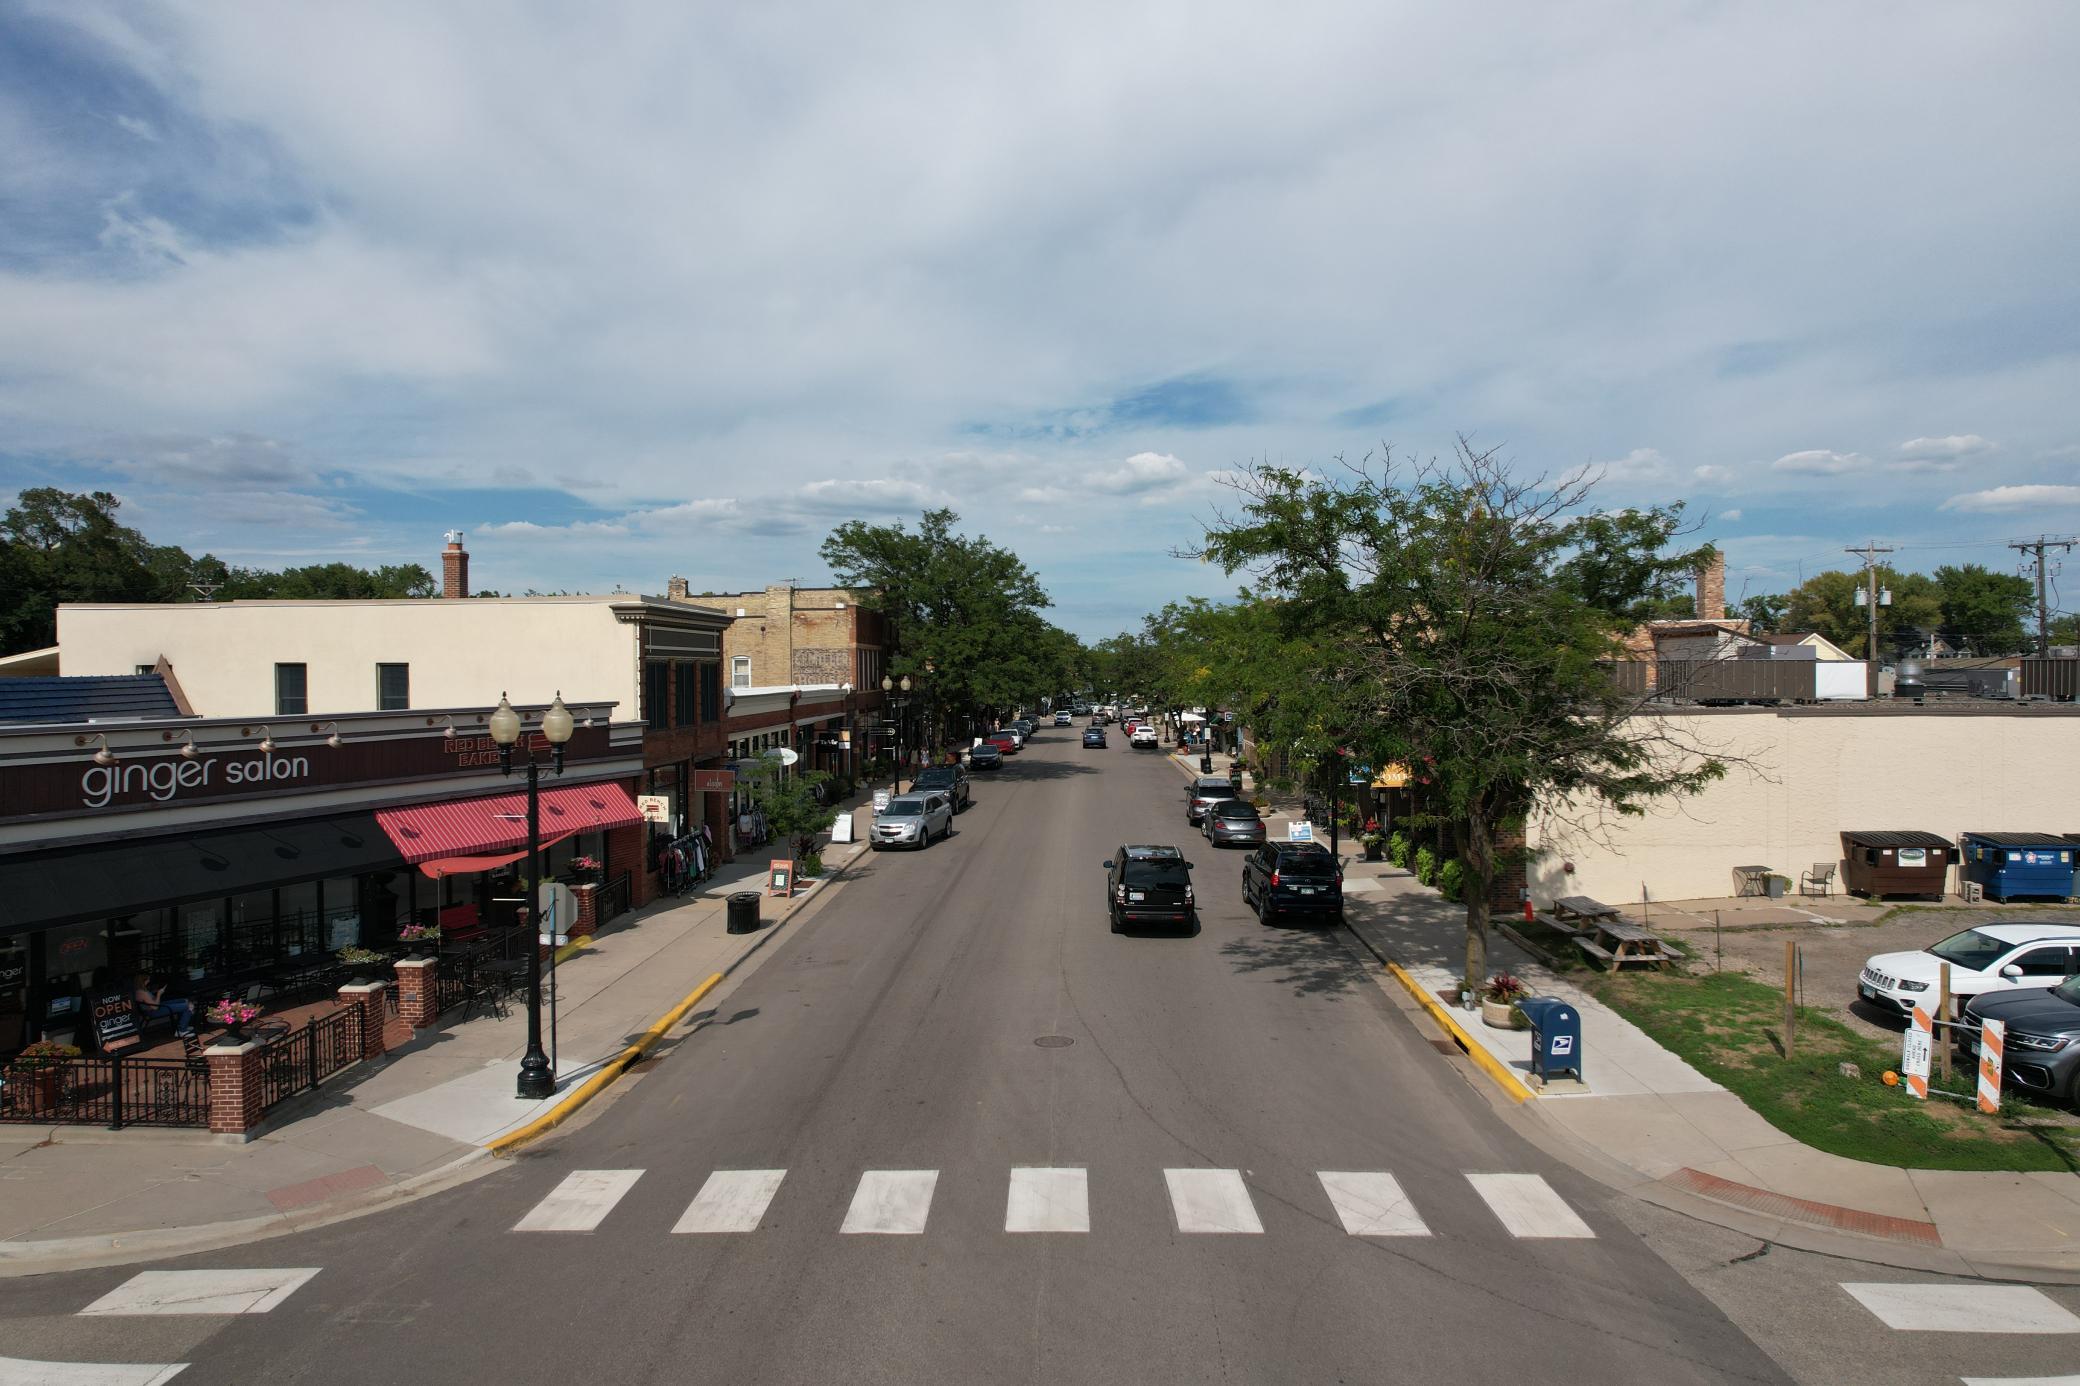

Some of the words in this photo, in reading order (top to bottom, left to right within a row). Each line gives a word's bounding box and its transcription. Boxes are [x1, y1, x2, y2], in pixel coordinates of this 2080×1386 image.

[444, 738, 473, 753] RED
[477, 735, 524, 752] BEH
[82, 758, 217, 808] ginger
[226, 752, 308, 784] salon
[0, 966, 24, 980] nger
[102, 994, 121, 1005] NOW
[95, 999, 132, 1018] OPEN
[100, 1013, 132, 1030] ginger
